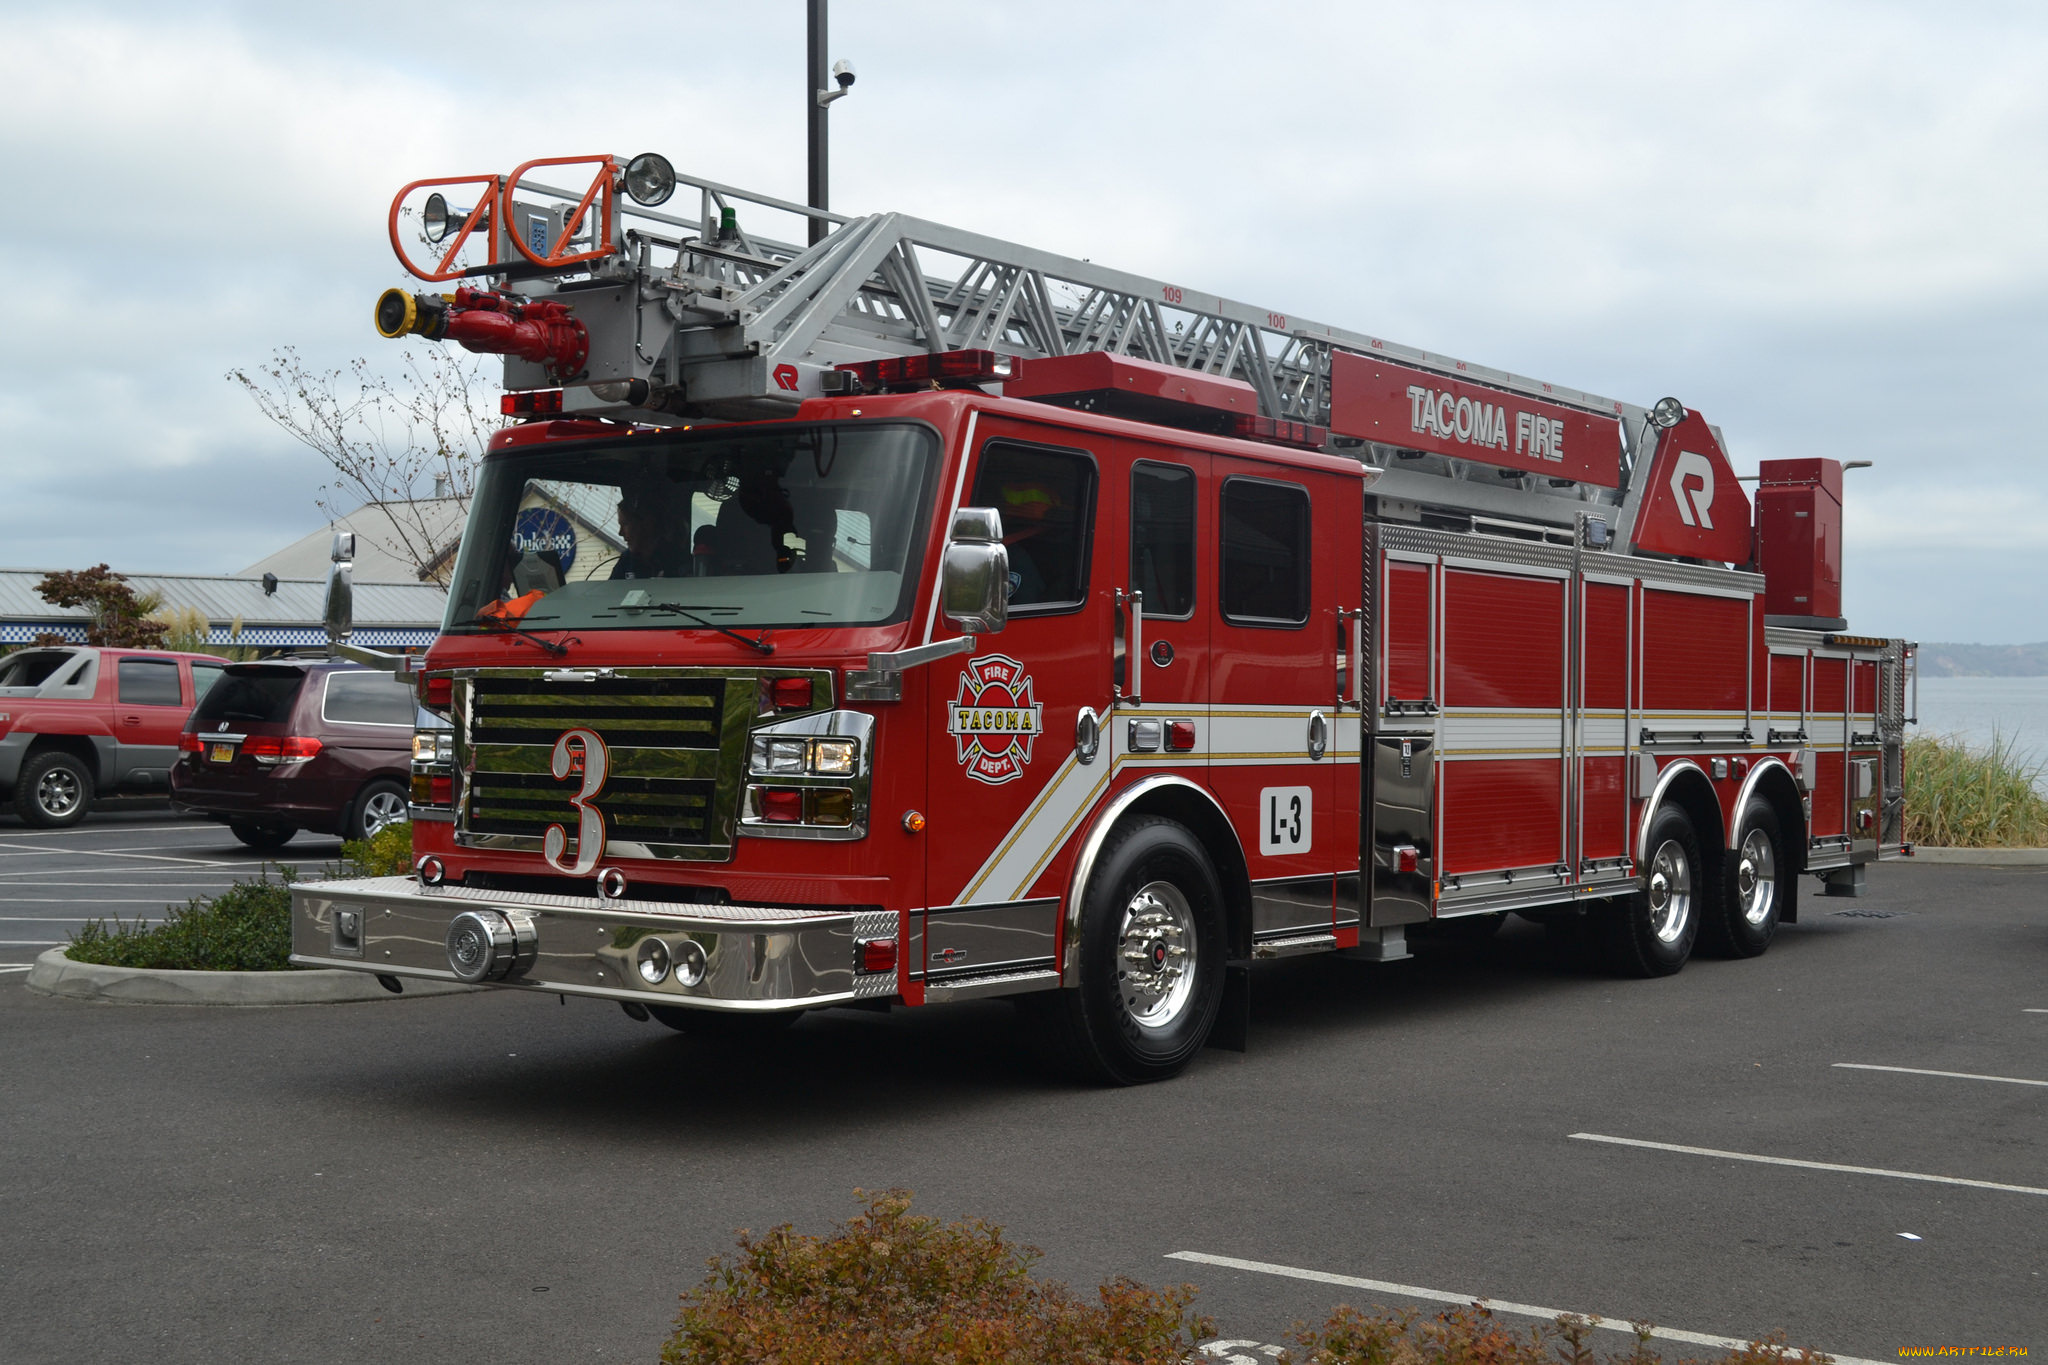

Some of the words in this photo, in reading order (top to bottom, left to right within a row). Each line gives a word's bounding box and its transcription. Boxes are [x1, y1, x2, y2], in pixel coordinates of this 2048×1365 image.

[1162, 286, 1182, 304] 109
[1267, 312, 1285, 329] 100
[1406, 385, 1508, 451] TACOMA
[1516, 411, 1564, 463] FIRE
[984, 666, 1009, 680] FIRE
[959, 711, 1032, 731] TACOMA
[980, 758, 1010, 773] DEPT.
[543, 727, 608, 877] 3
[1271, 795, 1301, 844] L-3
